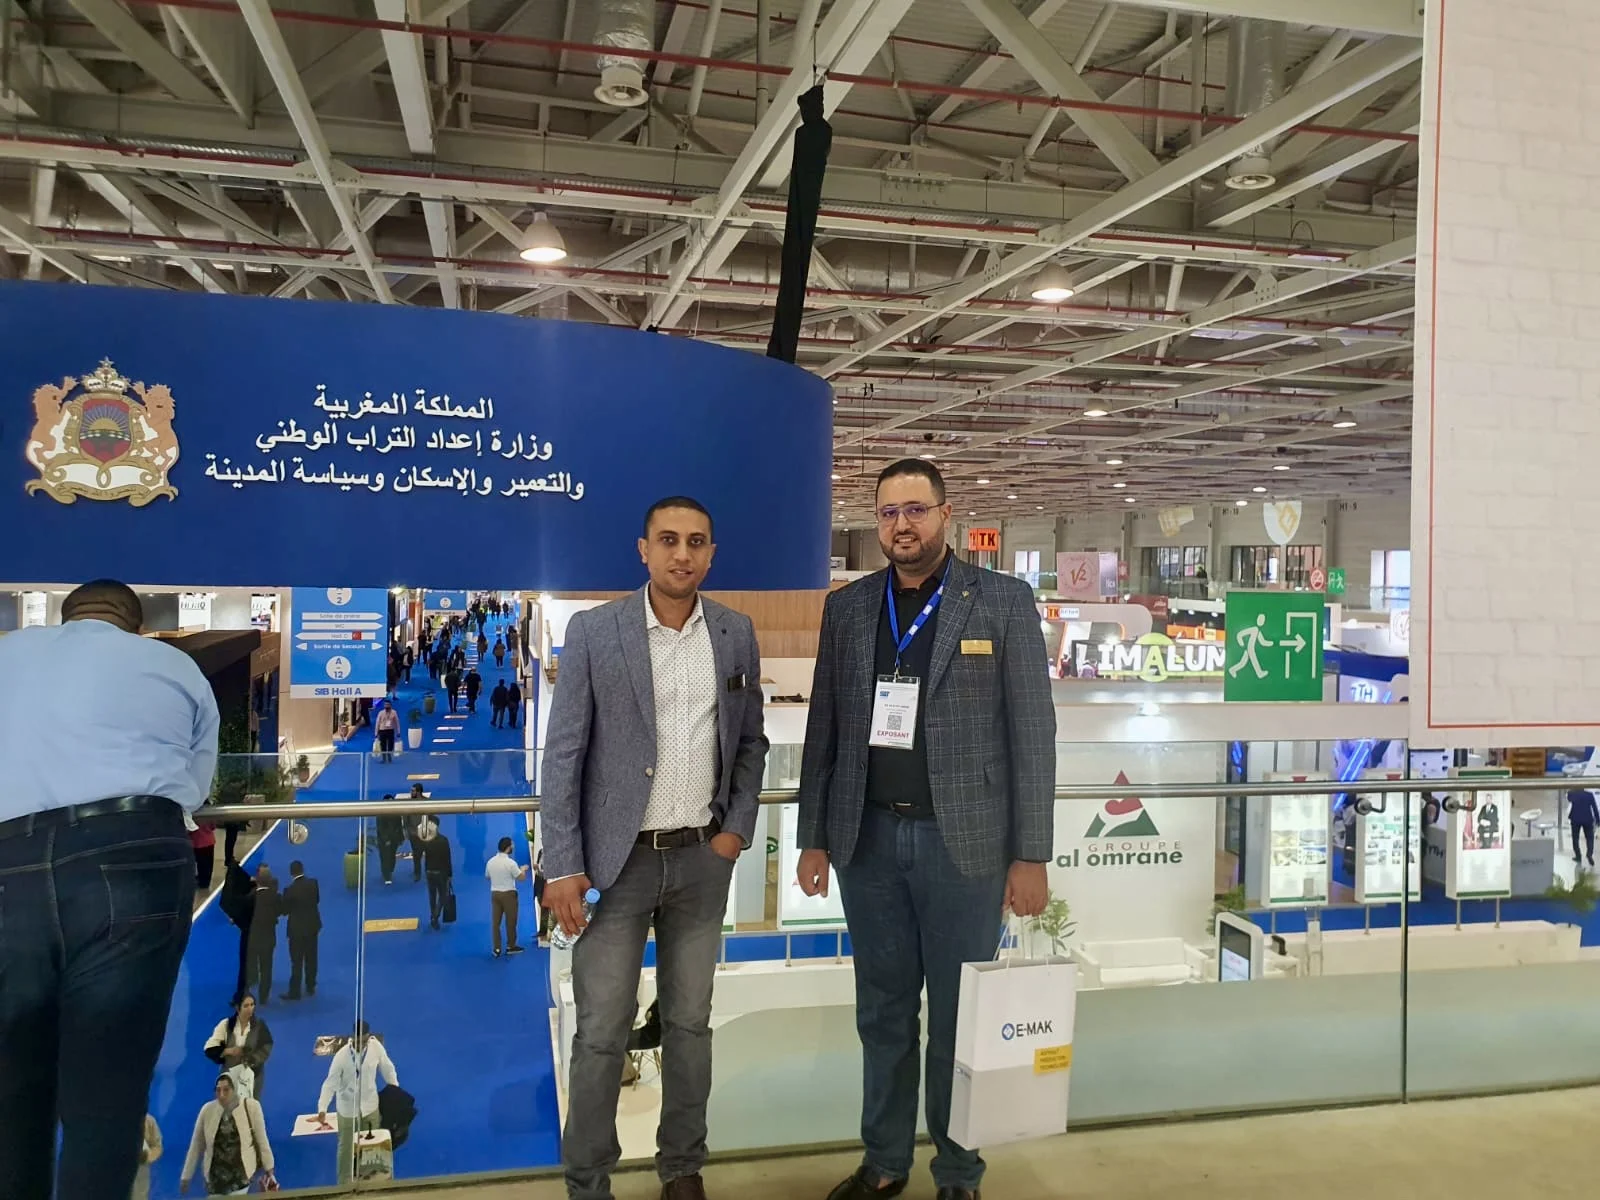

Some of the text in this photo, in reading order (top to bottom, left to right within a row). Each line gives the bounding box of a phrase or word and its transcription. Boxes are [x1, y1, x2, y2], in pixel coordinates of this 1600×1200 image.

[313, 384, 494, 420] المملكة المغربية
[255, 418, 553, 461] وزارة إعداد التراب الوطني
[204, 453, 585, 501] والتعمير والإسكان وسياسة المدينة
[979, 532, 996, 547] TK
[335, 657, 342, 665] A
[334, 671, 343, 679] 12
[331, 687, 352, 695] Hall
[354, 687, 362, 695] A
[876, 730, 909, 739] EXPOSANT
[1088, 840, 1181, 853] GROUPE
[1056, 848, 1183, 868] al omrane
[1016, 1019, 1053, 1037] E-MAK
